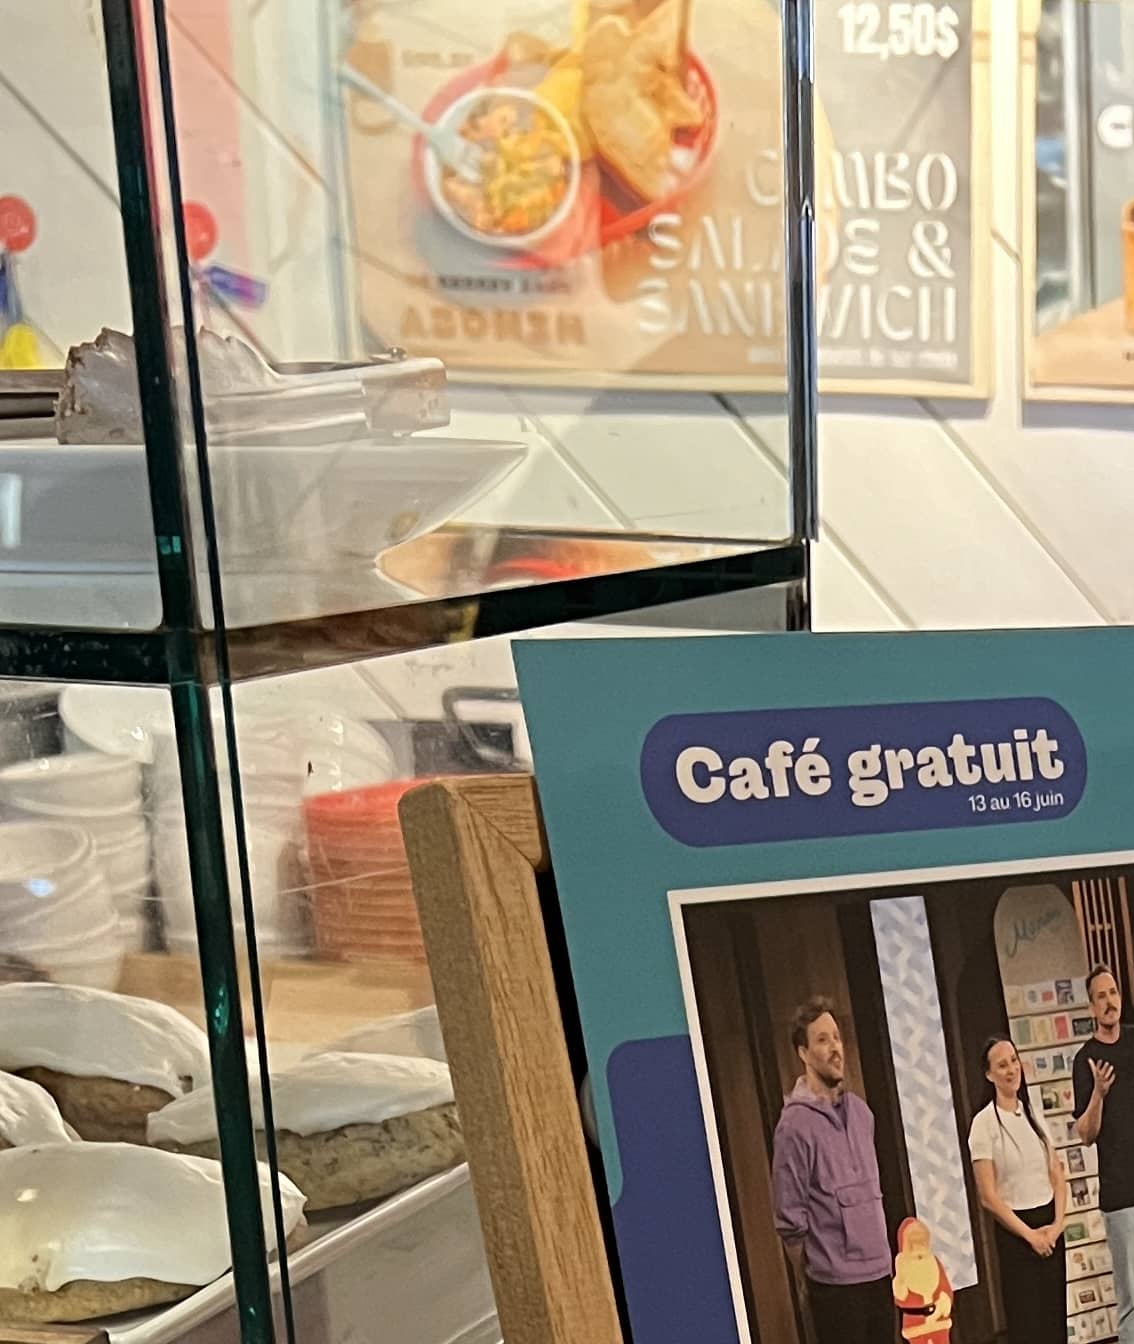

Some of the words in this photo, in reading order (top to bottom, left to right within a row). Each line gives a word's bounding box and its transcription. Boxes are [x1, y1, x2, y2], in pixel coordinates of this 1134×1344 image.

[838, 3, 959, 60] 12,50$
[747, 150, 958, 211] CMBO
[907, 220, 955, 278] &
[676, 737, 832, 804] Café
[848, 729, 1065, 807] gratuit
[968, 794, 987, 812] 13
[990, 797, 1010, 811] au
[1012, 791, 1032, 809] 16
[1032, 791, 1064, 812] juin
